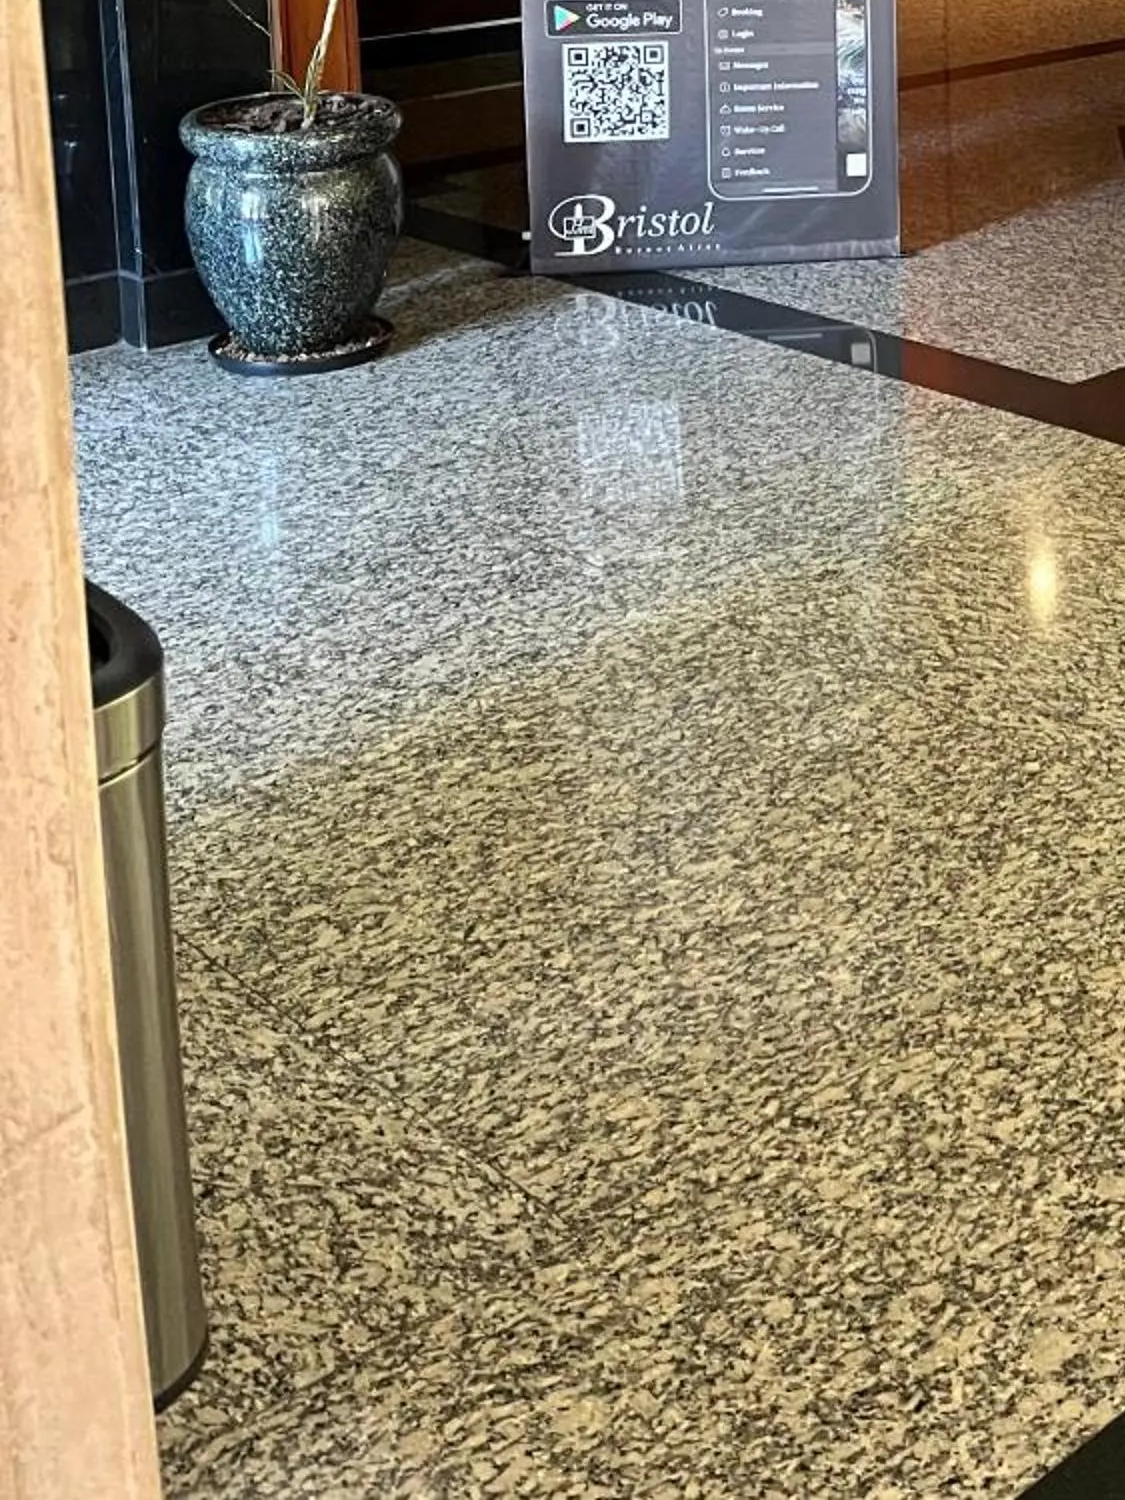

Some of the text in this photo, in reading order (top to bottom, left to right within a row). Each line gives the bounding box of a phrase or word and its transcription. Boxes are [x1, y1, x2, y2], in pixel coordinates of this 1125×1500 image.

[585, 3, 603, 11] GET
[613, 3, 628, 11] ON
[586, 11, 673, 31] Google Play
[548, 194, 715, 257] Bristol
